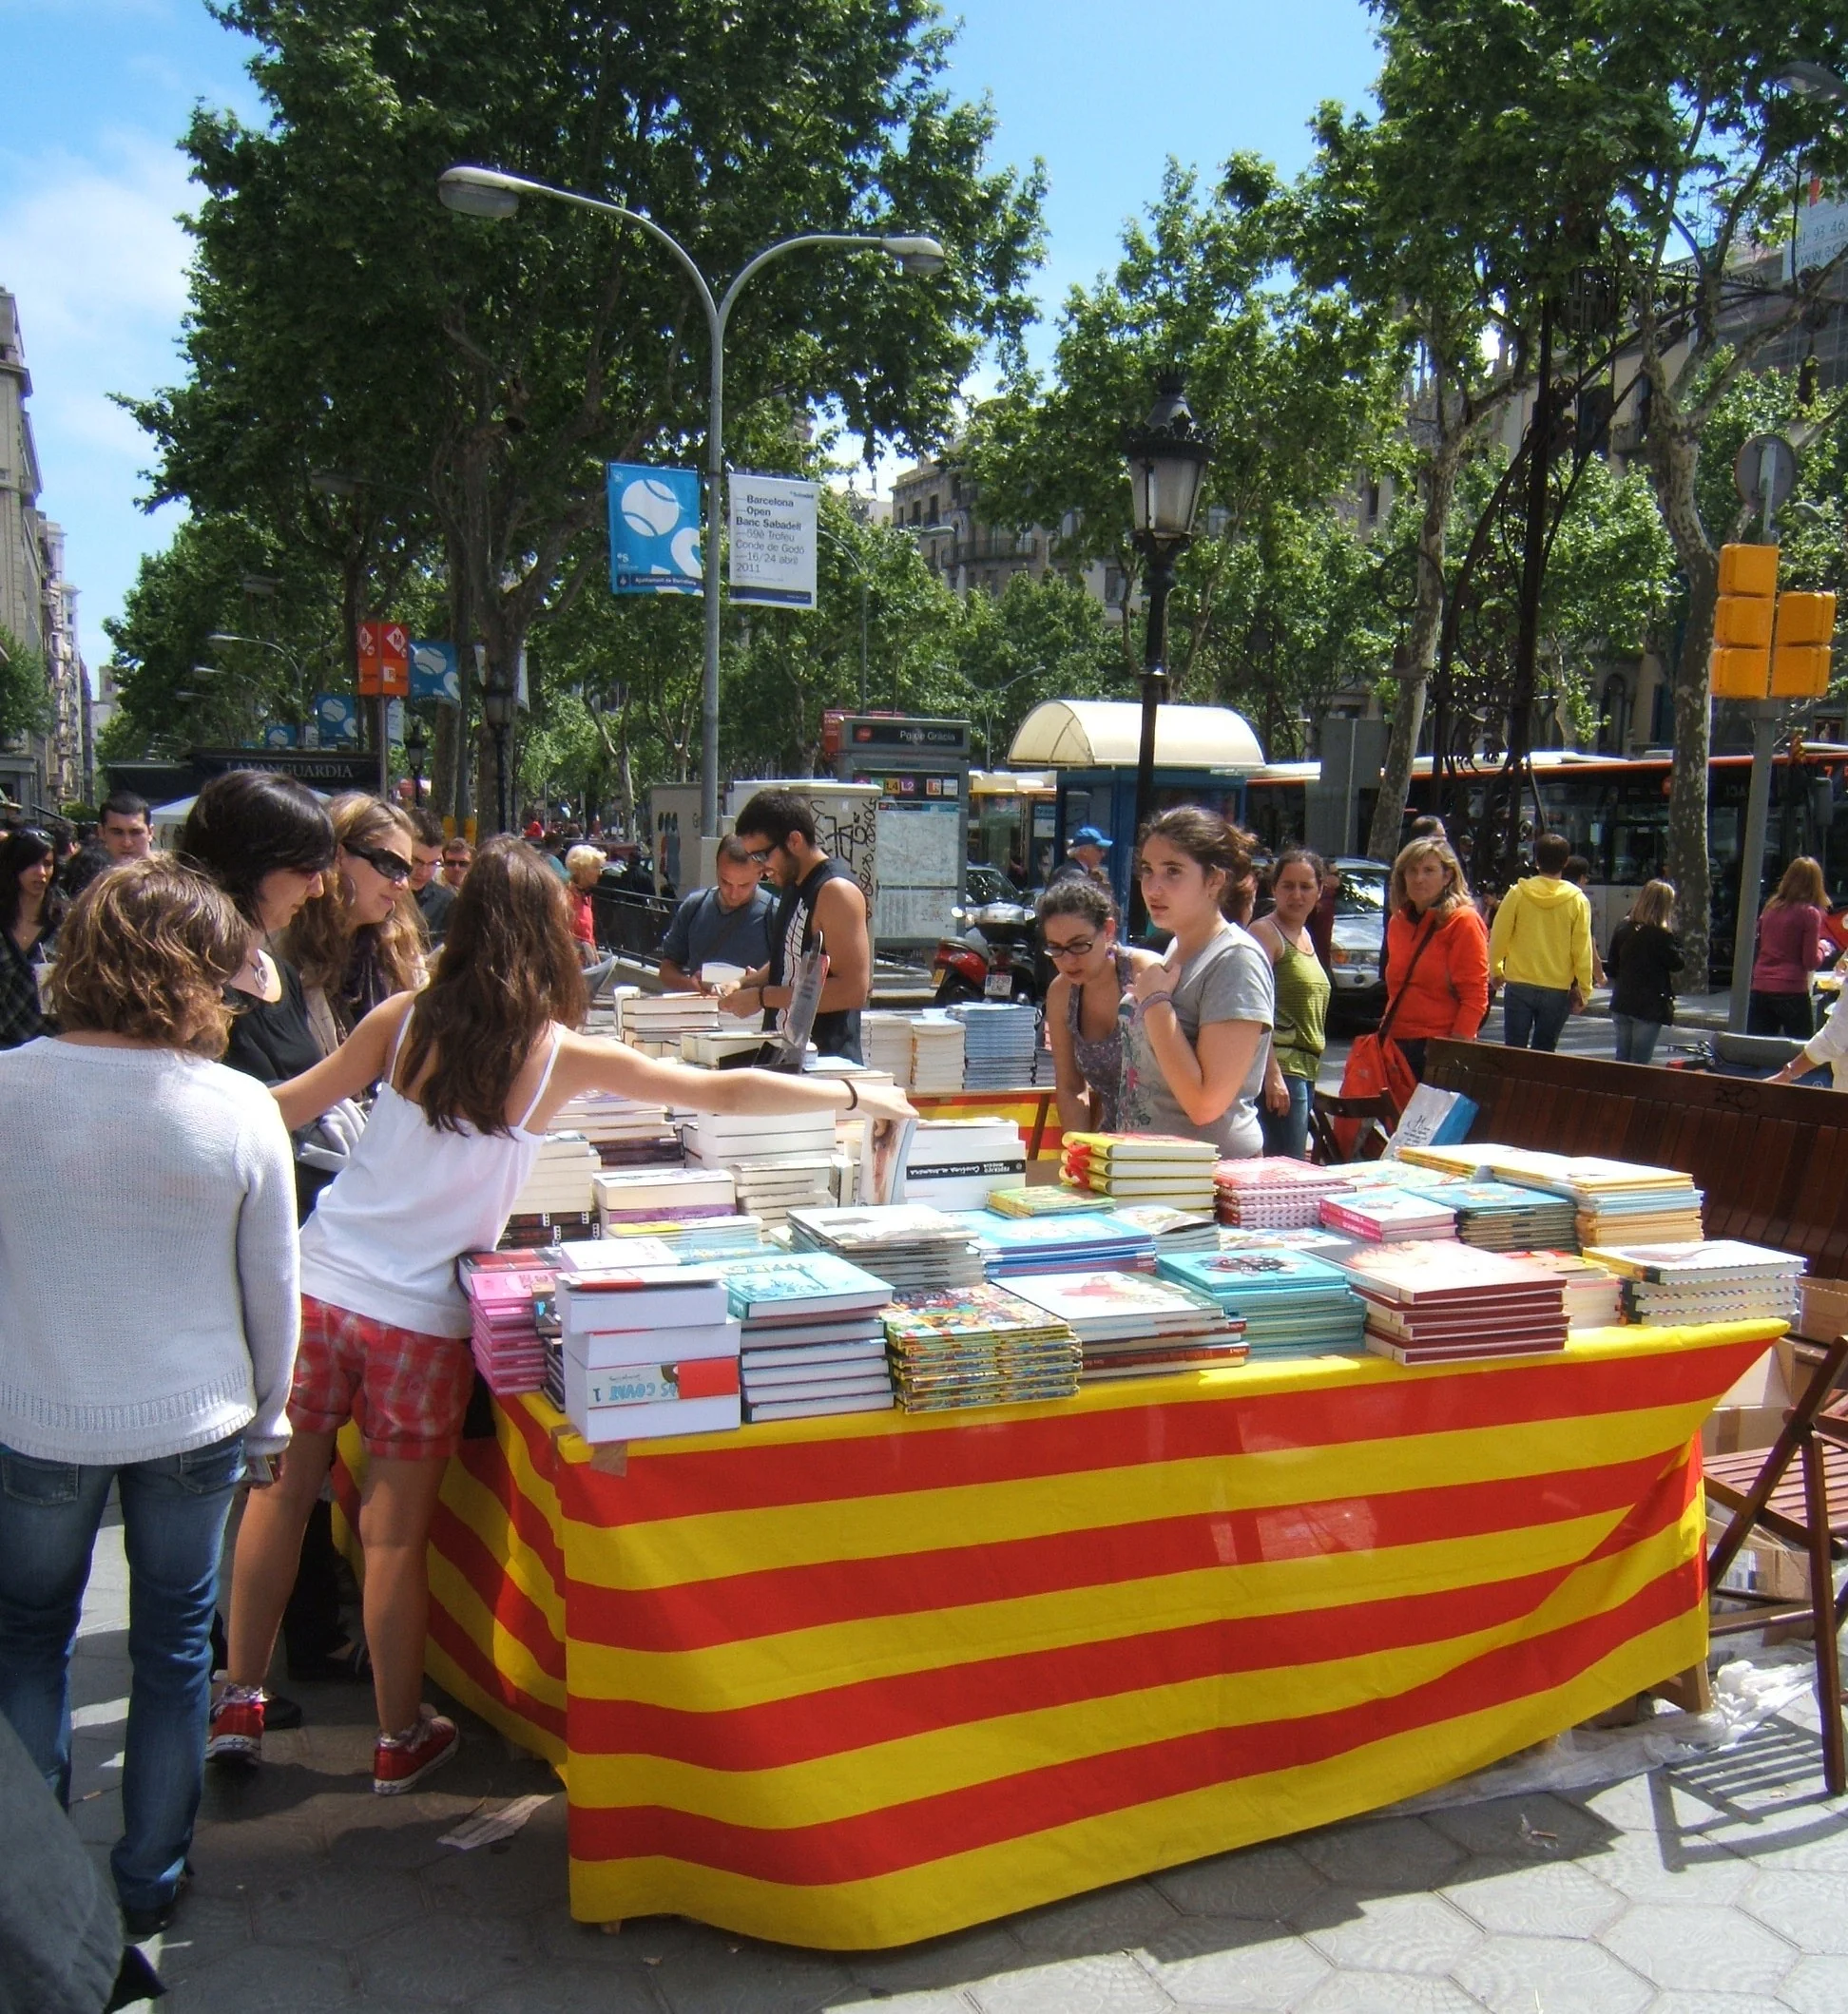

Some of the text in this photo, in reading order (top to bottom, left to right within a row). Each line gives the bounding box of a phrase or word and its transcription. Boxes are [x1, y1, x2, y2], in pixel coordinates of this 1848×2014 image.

[746, 494, 794, 508] Barcelona
[746, 507, 771, 518] Open
[736, 516, 802, 530] Banc Sabadell
[768, 530, 795, 542] Trofeu
[735, 539, 765, 550] Conde
[766, 541, 780, 551] de
[779, 554, 799, 565] abril
[736, 563, 760, 573] 2011
[244, 763, 354, 778] VANGUARDIA
[886, 781, 898, 791] L4
[901, 781, 914, 792] L2
